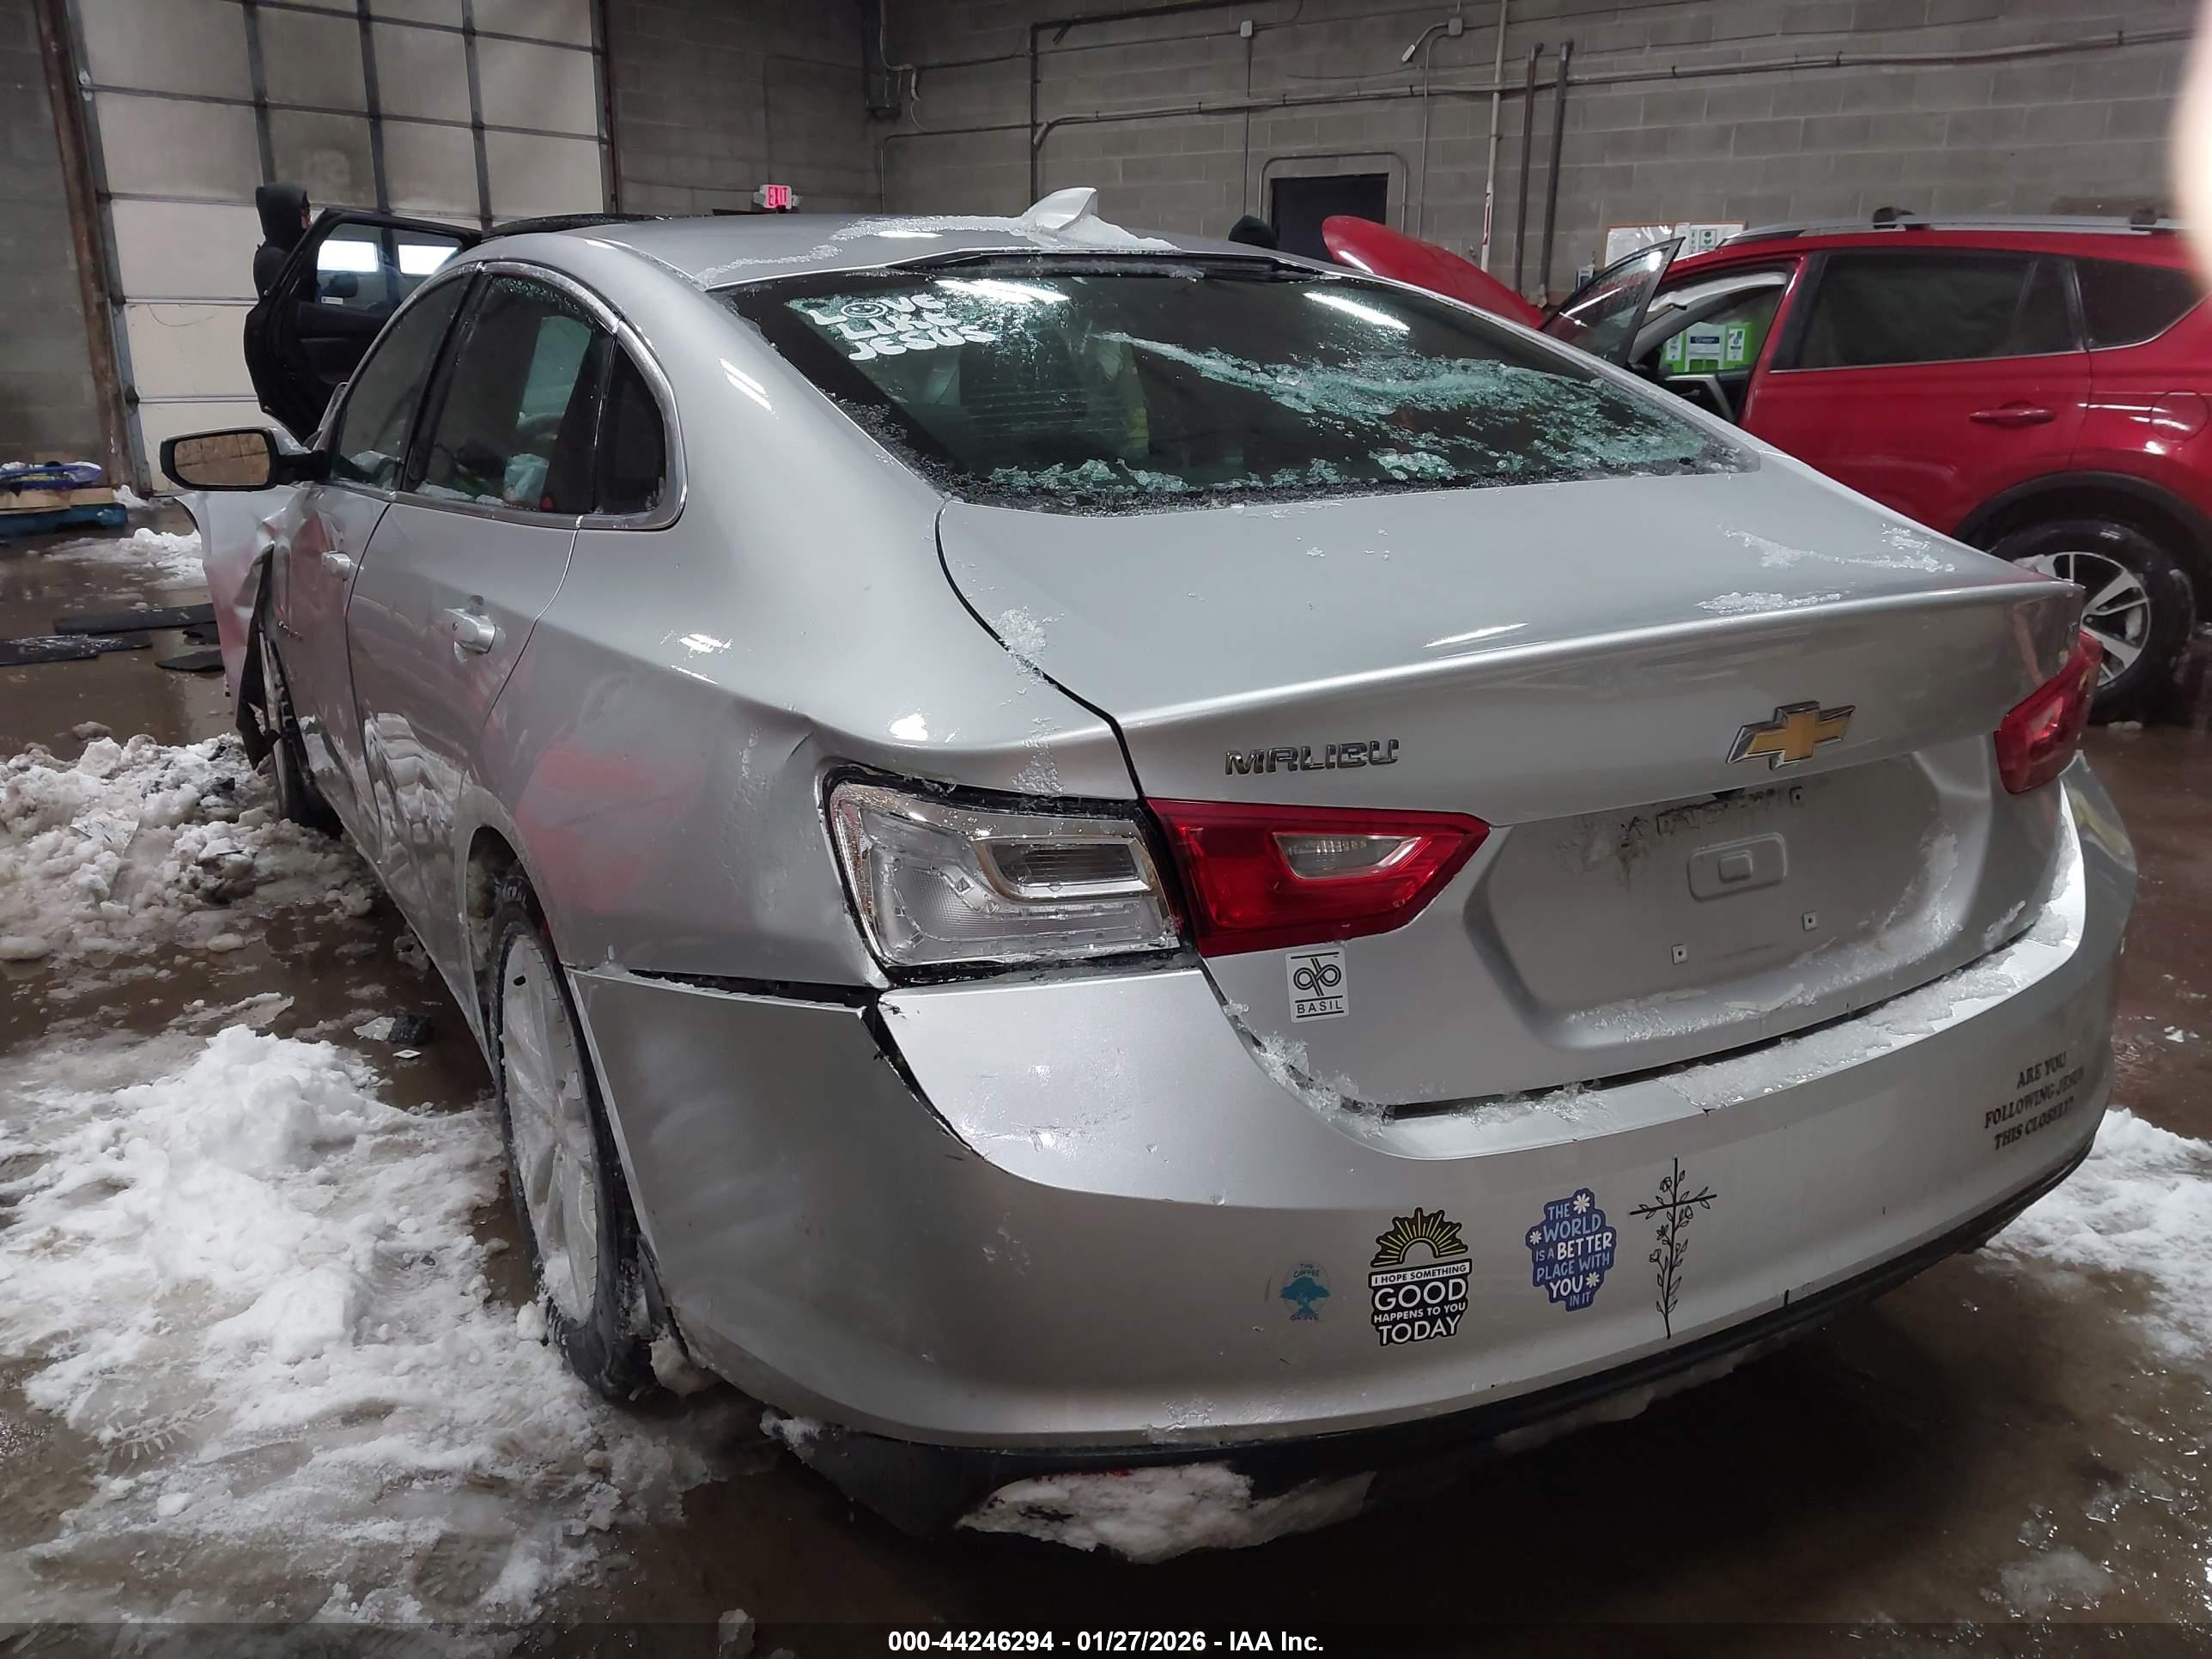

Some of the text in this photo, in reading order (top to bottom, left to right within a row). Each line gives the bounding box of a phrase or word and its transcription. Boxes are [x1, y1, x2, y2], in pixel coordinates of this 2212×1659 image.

[768, 185, 788, 207] EXIT
[836, 312, 962, 341] LIKE
[848, 325, 998, 361] JESUS
[1224, 738, 1401, 775] MALIBU
[1297, 1001, 1343, 1014] BASIL
[2016, 1050, 2068, 1089] ARE YOU
[1984, 1083, 2056, 1129] FOLLOWING
[1994, 1123, 2024, 1150] THIS
[1547, 1202, 1571, 1221] THE
[1542, 1213, 1602, 1243] WORLD
[1535, 1231, 1613, 1262] IS A BETTER
[1381, 1273, 1407, 1284] HOPE
[1410, 1264, 1467, 1280] SOMETHING
[1536, 1250, 1610, 1282] PLACE WITH
[1374, 1278, 1467, 1311] GOOD
[1549, 1274, 1584, 1299] YOU
[1569, 1291, 1592, 1308] IN IT
[1374, 1302, 1466, 1323] HAPPENS TO YOU
[1378, 1314, 1462, 1345] TODAY
